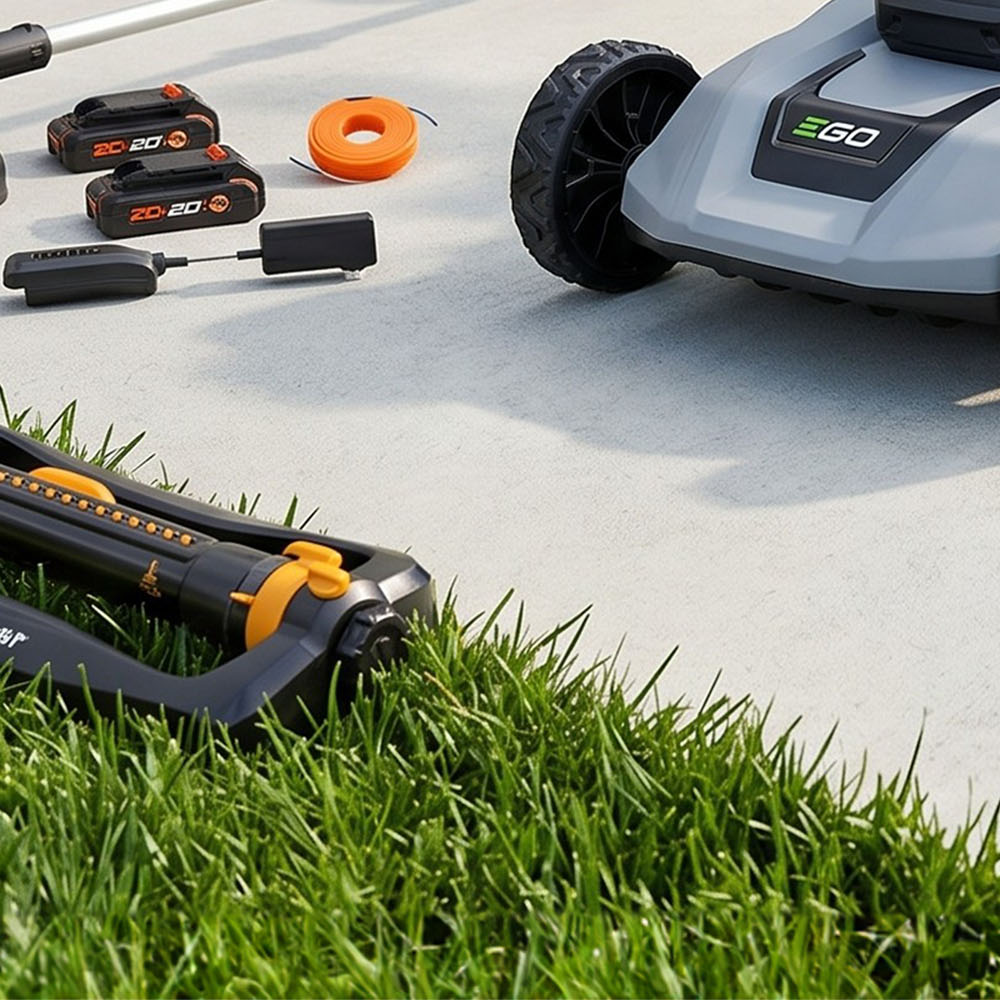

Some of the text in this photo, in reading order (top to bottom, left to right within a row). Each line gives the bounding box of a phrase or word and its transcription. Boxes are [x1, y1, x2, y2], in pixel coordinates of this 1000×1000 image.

[792, 115, 881, 148] EGO
[129, 135, 163, 152] 20
[167, 200, 202, 217] 20
